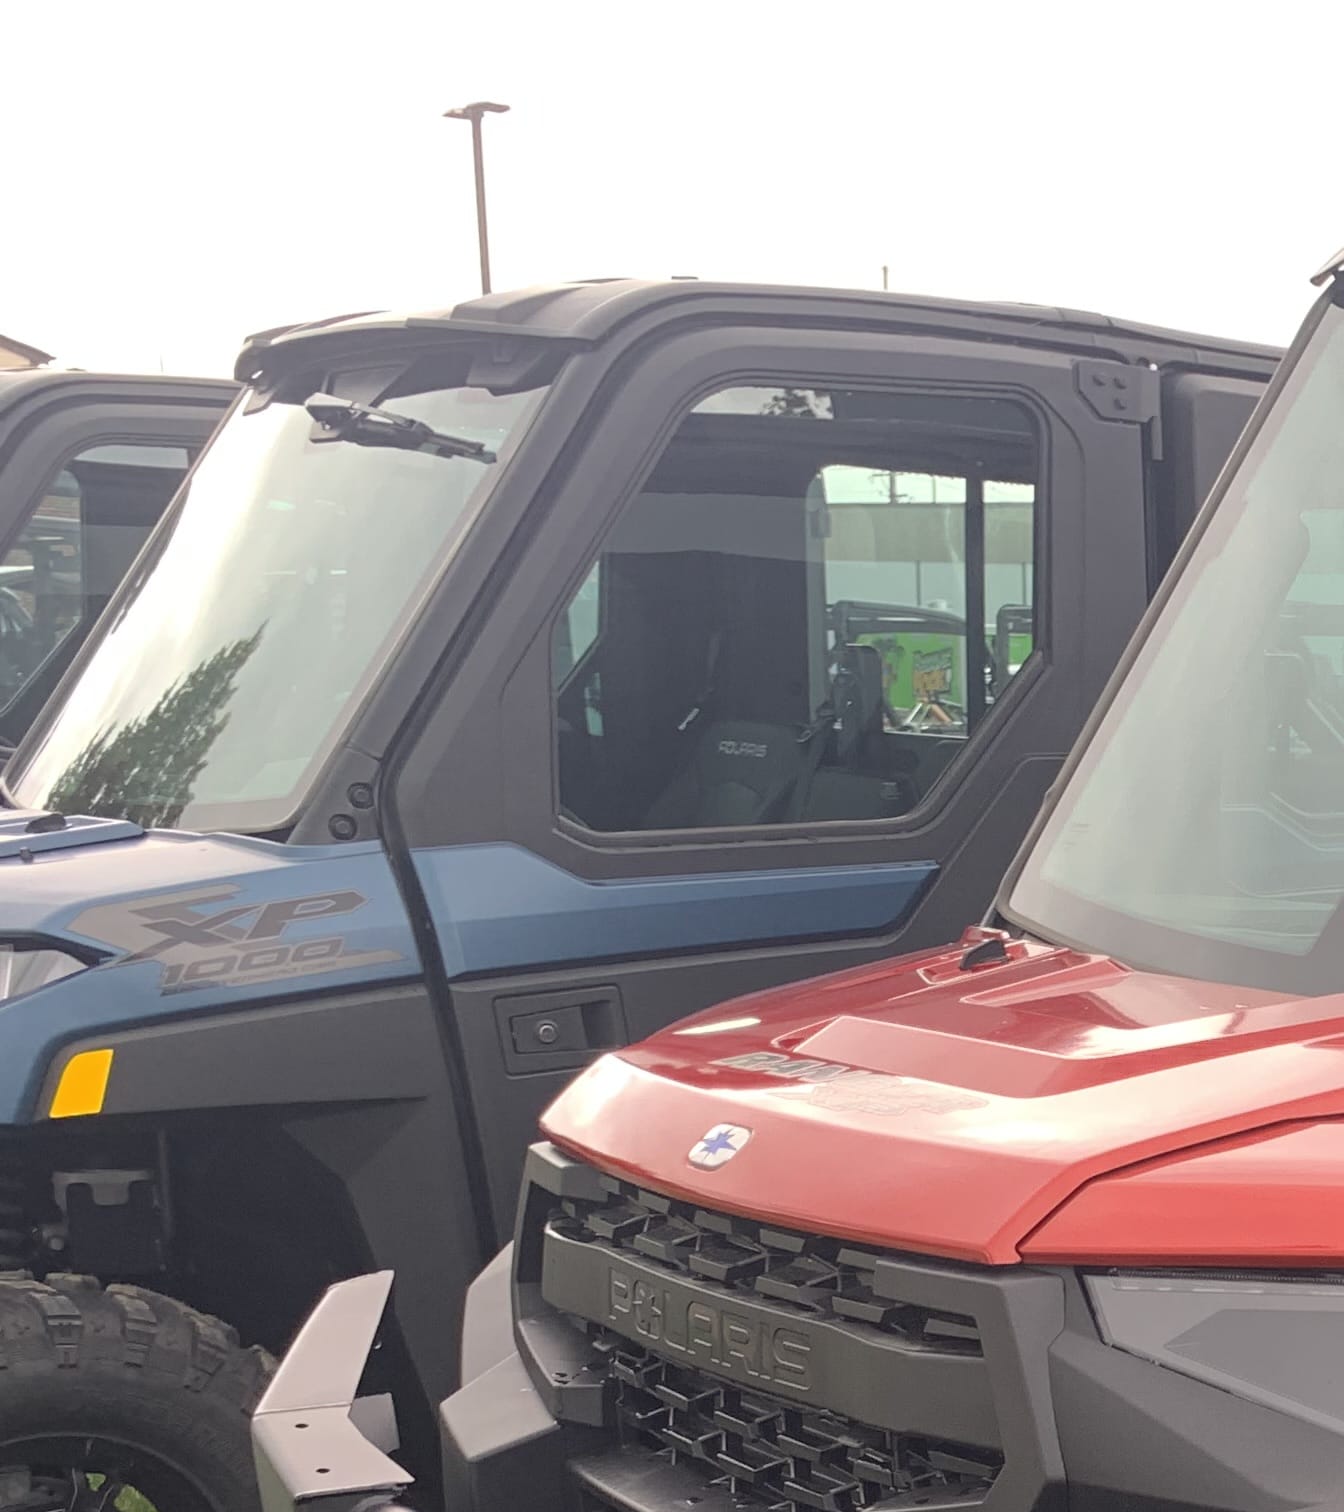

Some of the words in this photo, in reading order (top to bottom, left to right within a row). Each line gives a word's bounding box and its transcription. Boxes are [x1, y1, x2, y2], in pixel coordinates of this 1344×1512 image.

[115, 889, 368, 965] XP
[160, 937, 343, 988] 1000
[608, 1267, 813, 1391] POLARIS
